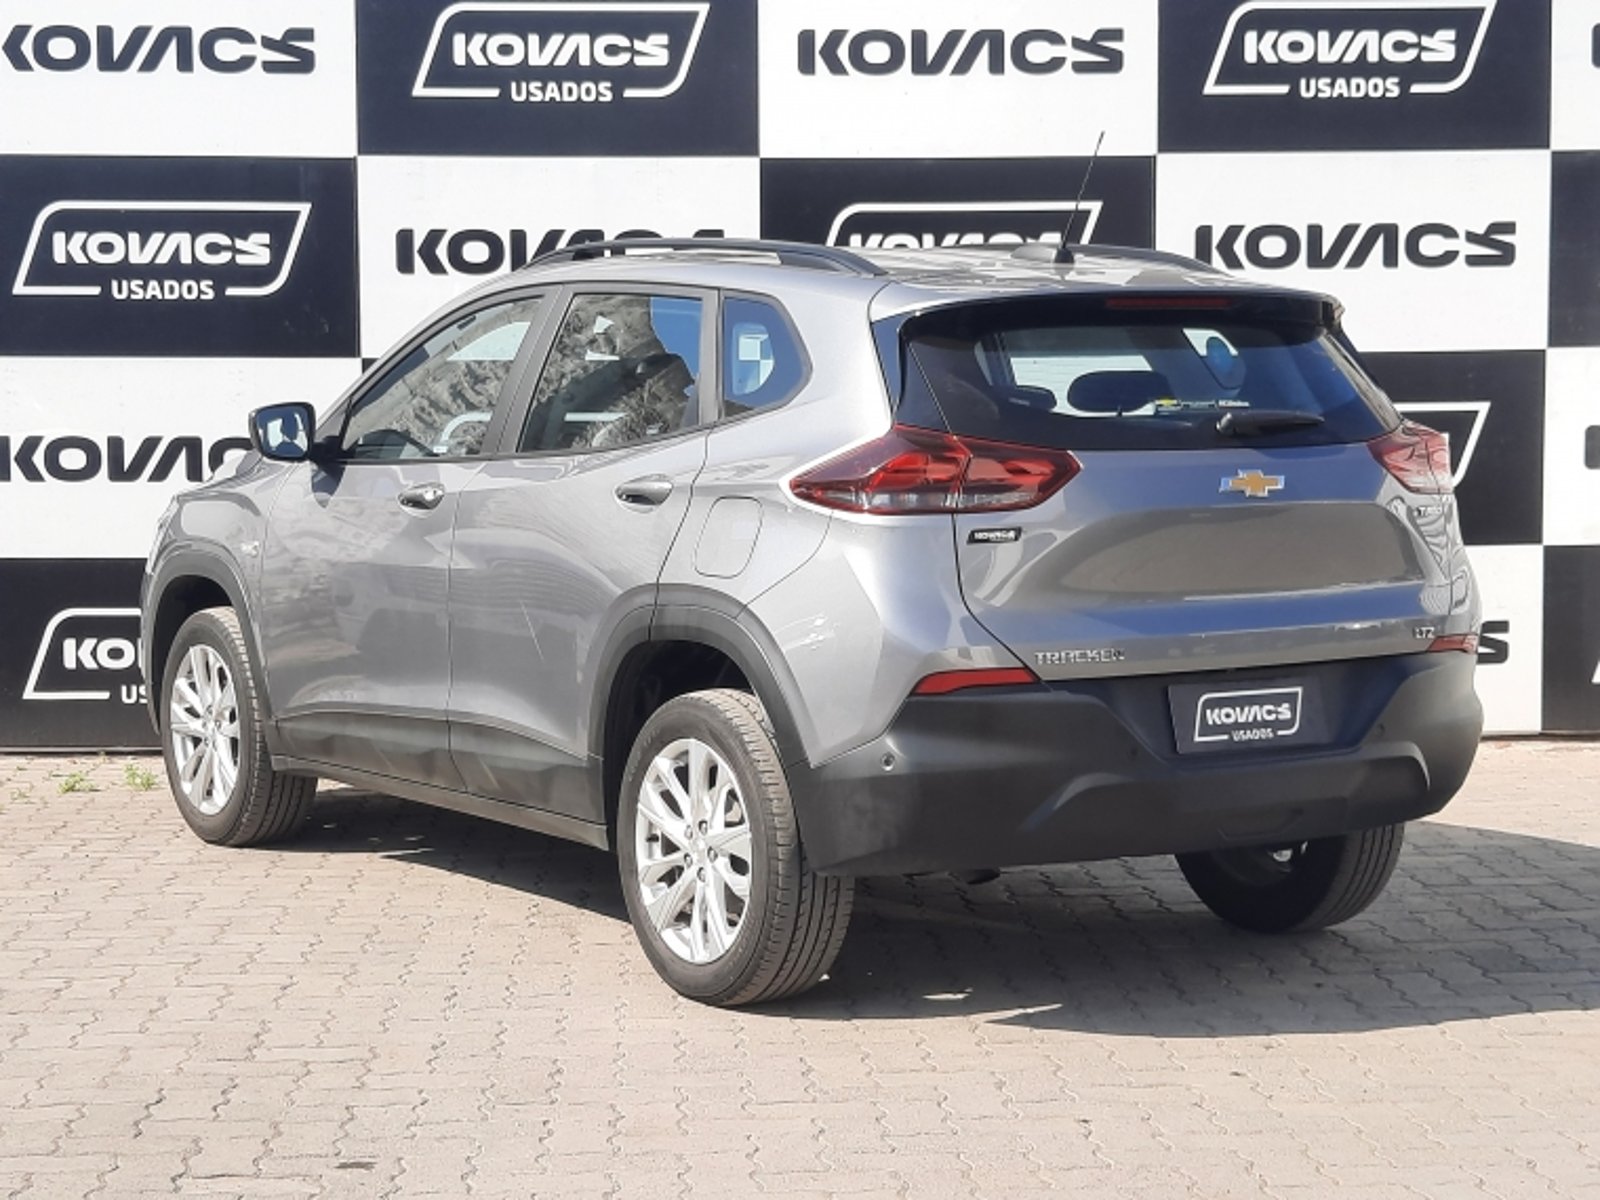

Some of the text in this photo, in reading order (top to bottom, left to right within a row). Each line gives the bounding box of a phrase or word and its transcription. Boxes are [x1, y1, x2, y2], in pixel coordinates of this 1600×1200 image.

[2, 25, 315, 74] KOVACS
[453, 33, 669, 66] KOVACS
[797, 28, 1124, 76] KOVACS
[1244, 29, 1456, 63] KOVACS
[511, 82, 612, 102] USADOS
[1300, 77, 1400, 98] USADOS
[52, 231, 271, 265] KOVACS
[395, 228, 725, 274] KOV
[1195, 222, 1517, 270] KOVACS
[112, 280, 215, 300] USADOS
[0, 435, 251, 482] KOVA
[1206, 703, 1292, 725] KOVACS
[1231, 728, 1274, 741] USADOS
